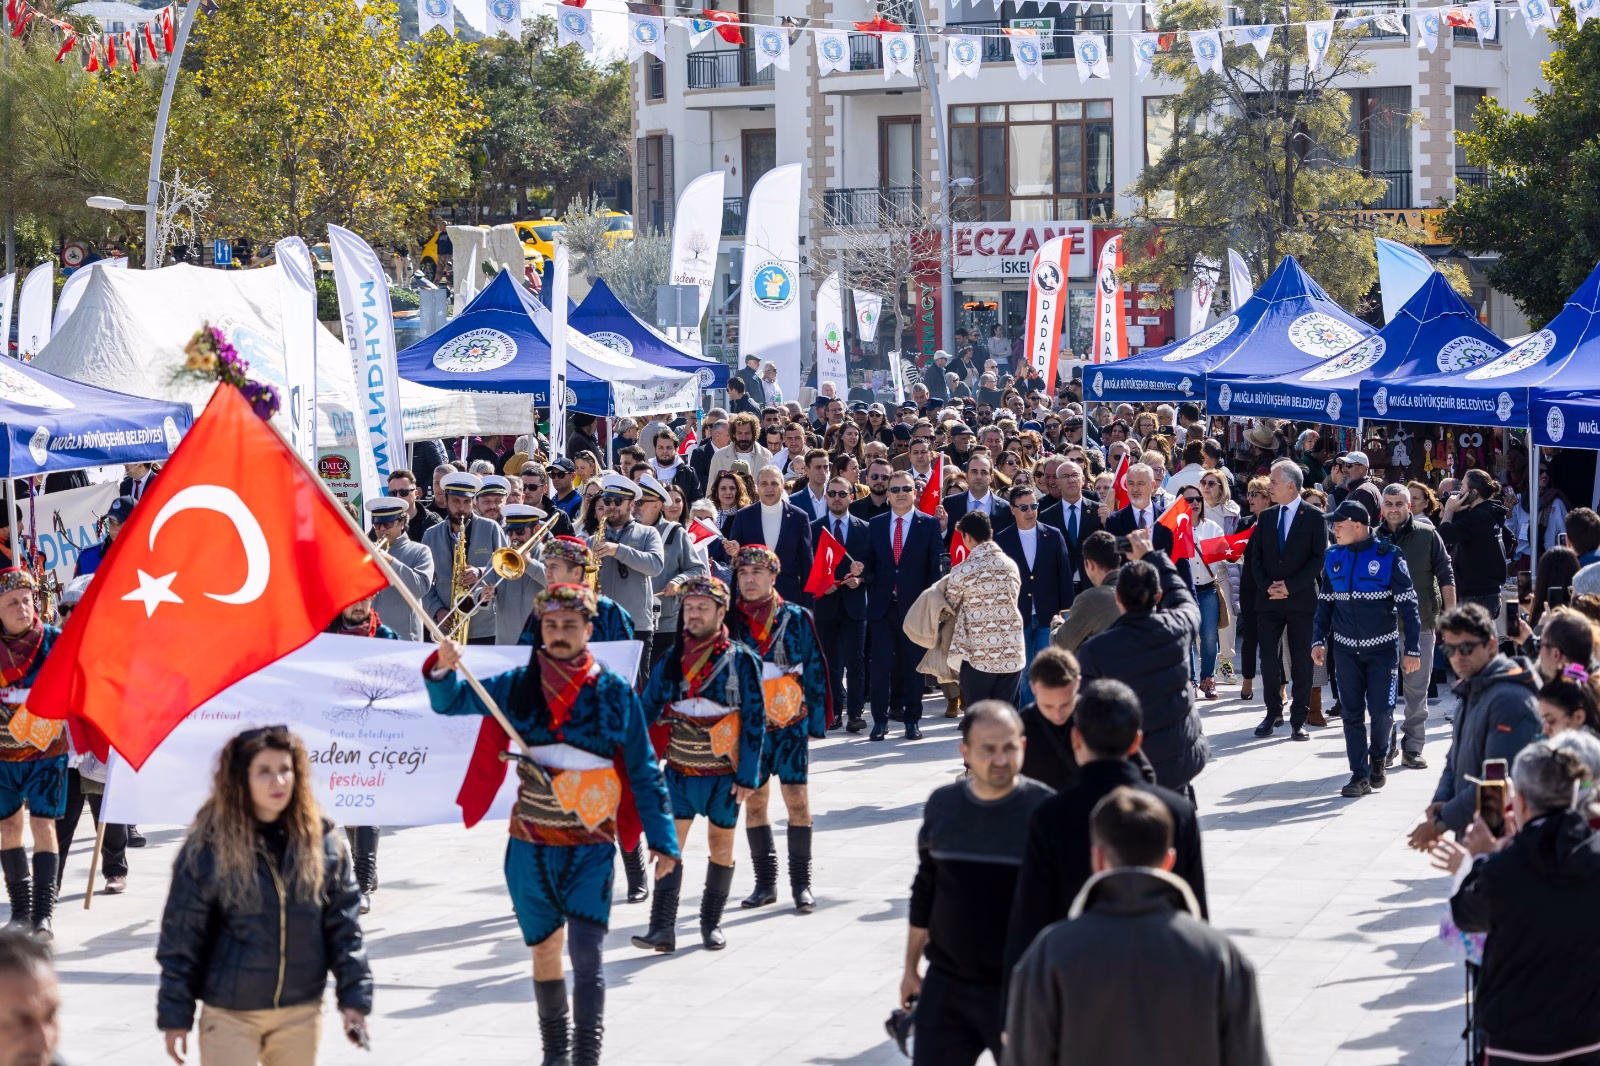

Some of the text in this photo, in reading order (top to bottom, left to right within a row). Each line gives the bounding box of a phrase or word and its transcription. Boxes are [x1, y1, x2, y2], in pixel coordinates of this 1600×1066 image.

[1233, 390, 1326, 410] MUĞLA BÜYÜKŞEHİR BELEDİYESİ
[1389, 394, 1495, 411] MUĞLA BÜYÜKŞEHİR BELEDİYESİ
[50, 426, 163, 451] MUĞLA BÜYÜKŞEHİR BELEDİYESİ
[200, 711, 241, 720] festival
[330, 729, 404, 741] Datça Belediyesi
[368, 746, 429, 775] çiçeği
[329, 769, 387, 791] festivali
[335, 794, 376, 807] 2025
